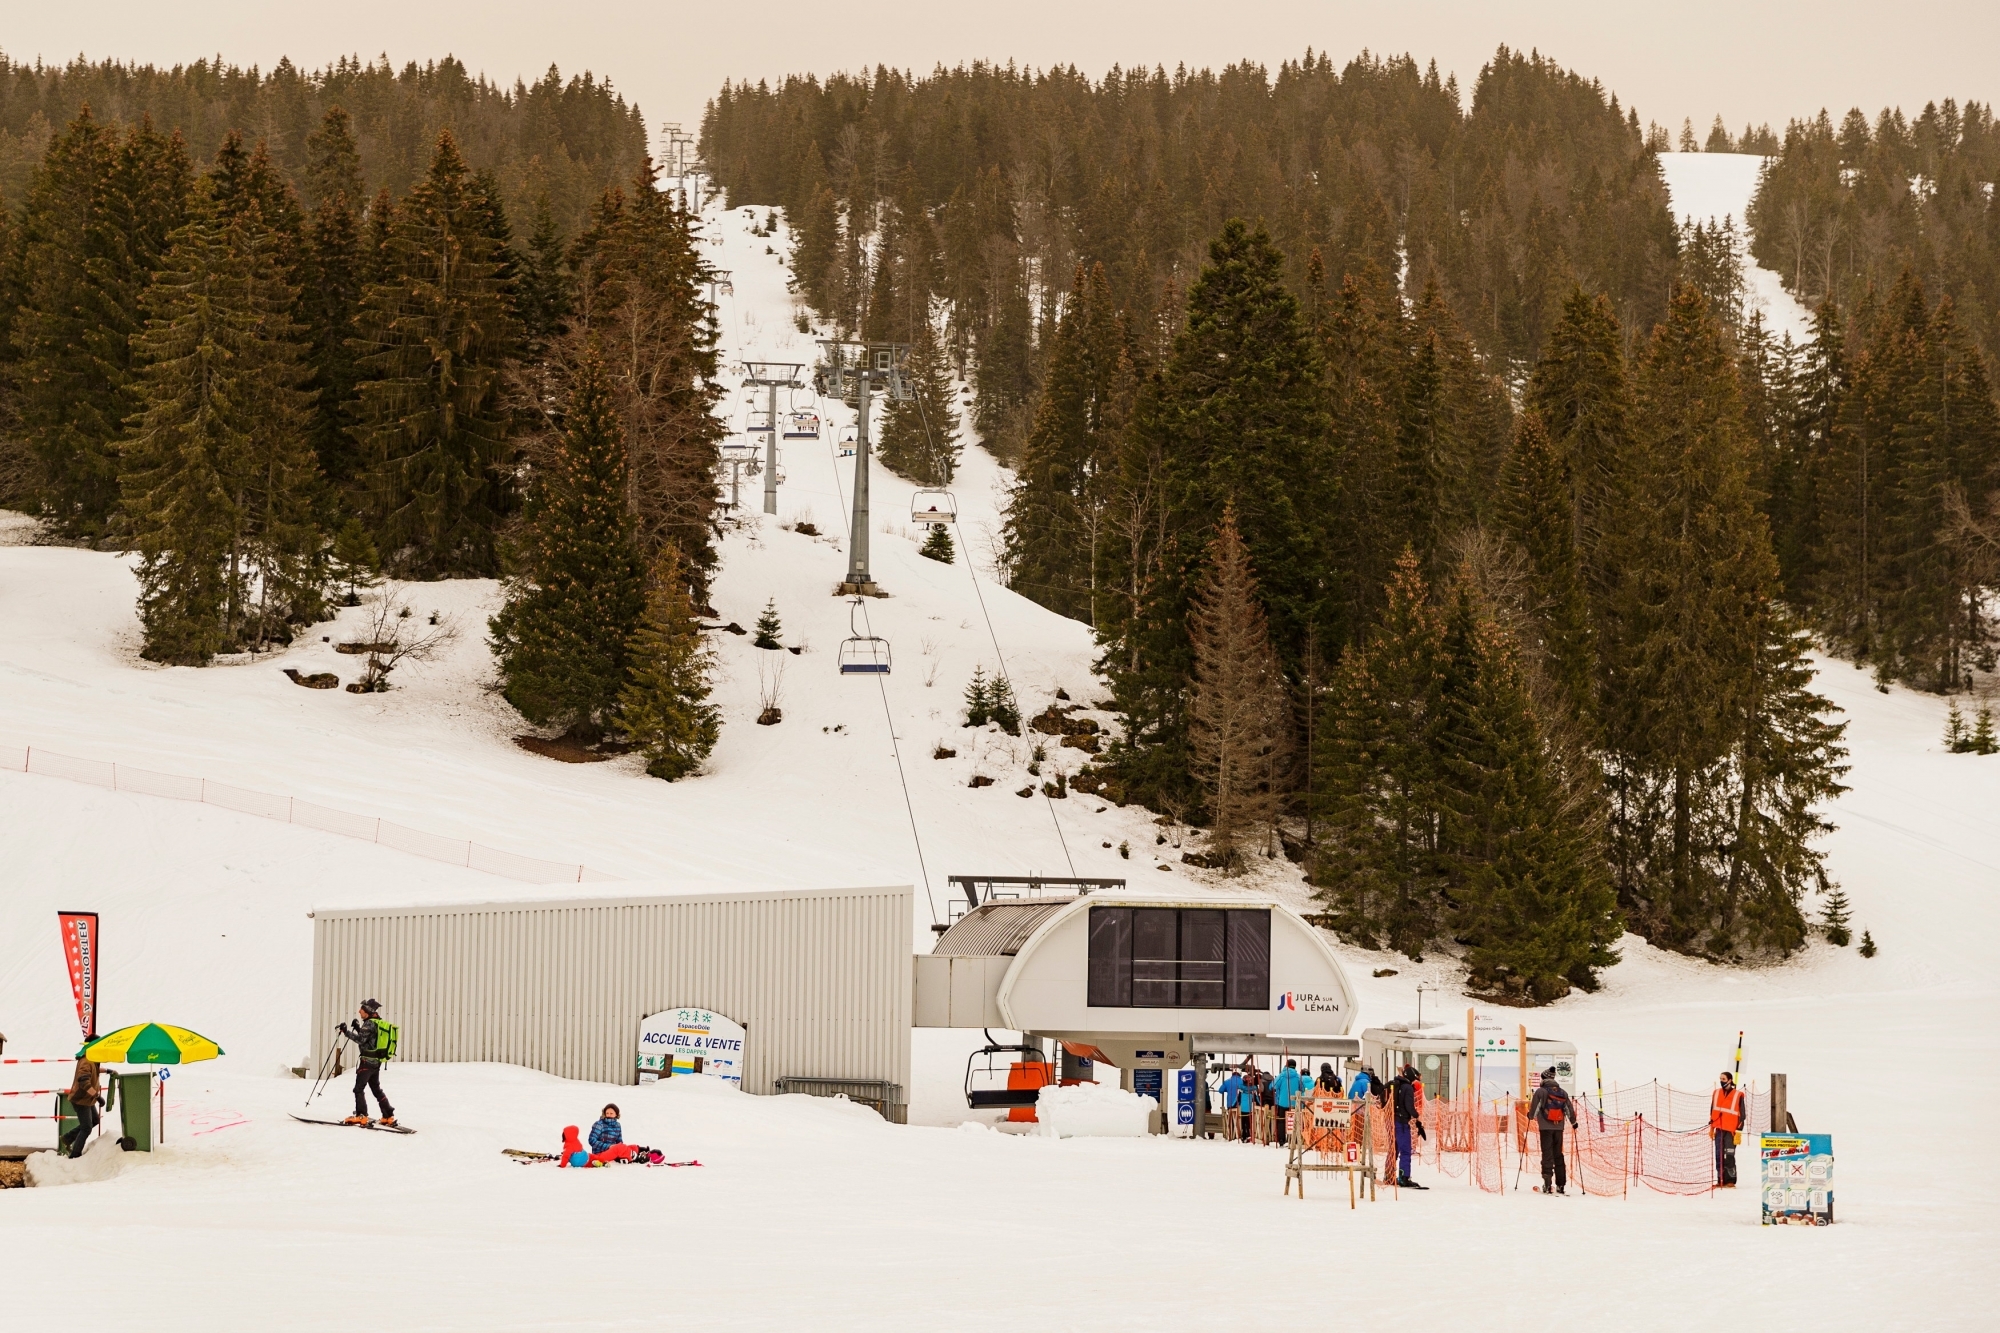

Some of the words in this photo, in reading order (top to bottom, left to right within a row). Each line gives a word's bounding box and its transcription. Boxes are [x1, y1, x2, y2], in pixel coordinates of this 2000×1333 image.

[1295, 993, 1321, 1002] JURA
[1304, 1001, 1339, 1012] LÉMAN
[642, 1032, 691, 1047] ACCUEIL
[694, 1036, 703, 1048] &
[705, 1037, 742, 1051] VENTE
[686, 1048, 707, 1056] DAPPES
[1780, 1147, 1804, 1156] CORONA
